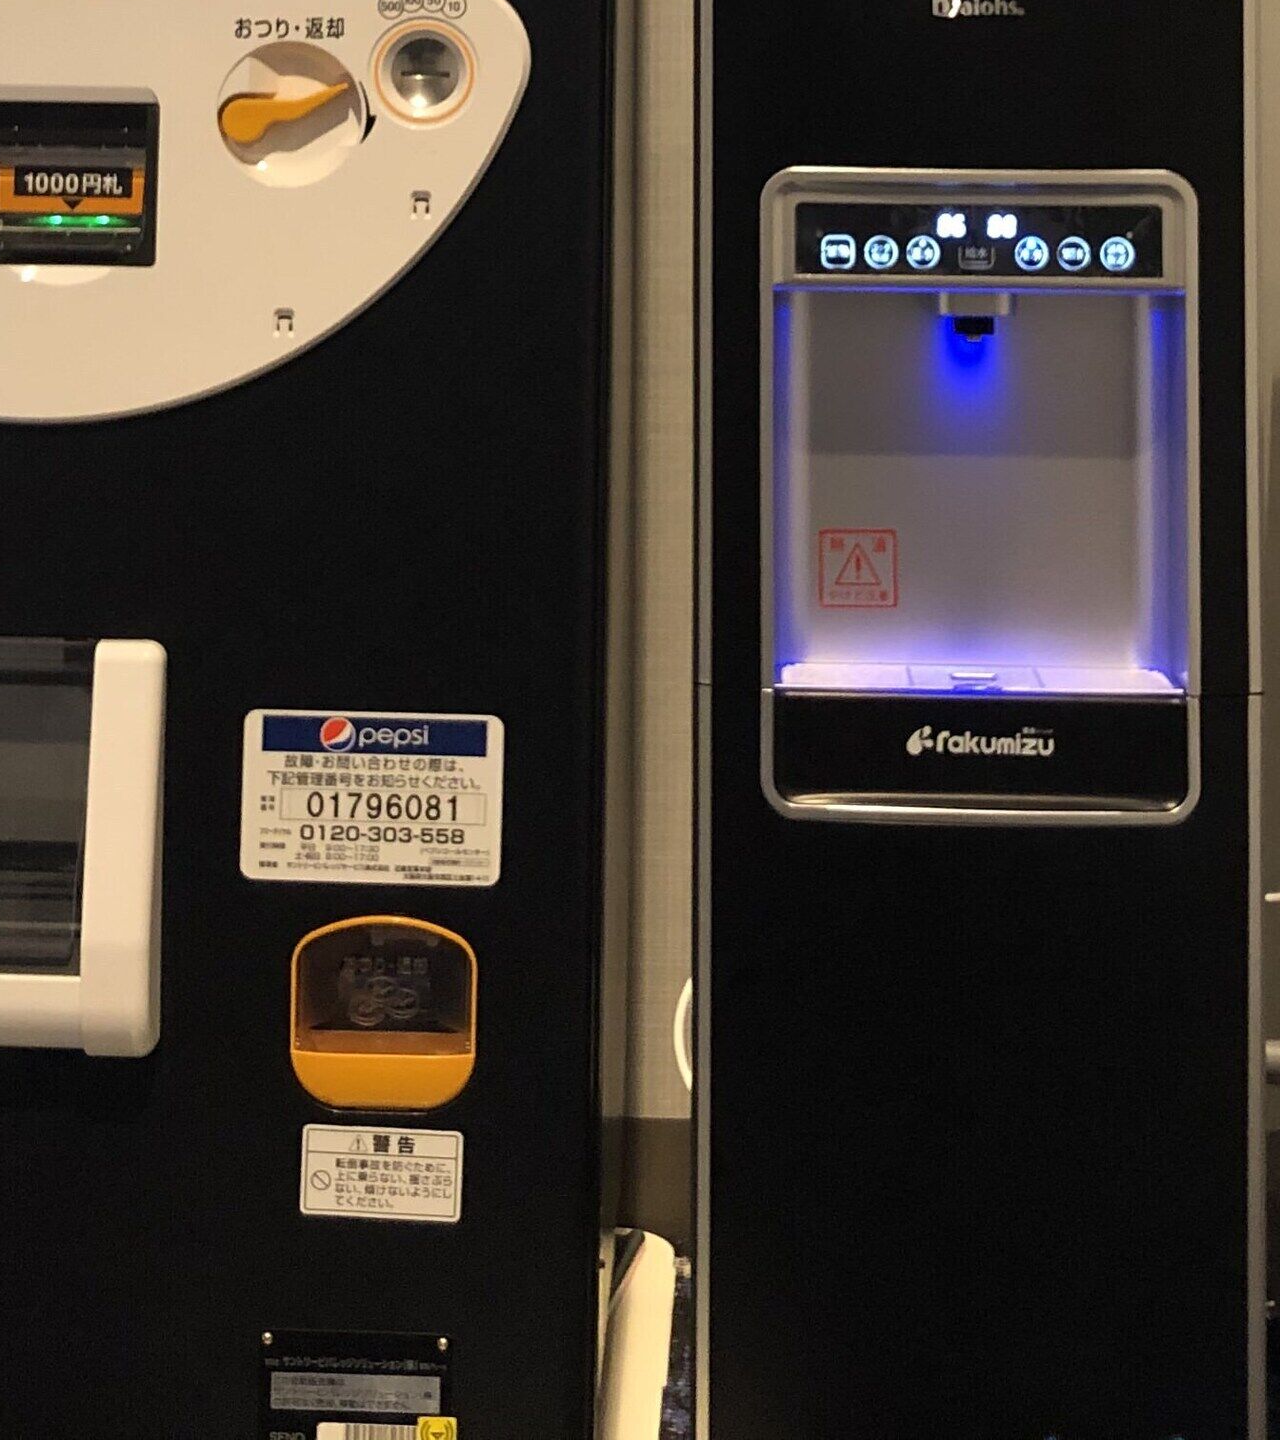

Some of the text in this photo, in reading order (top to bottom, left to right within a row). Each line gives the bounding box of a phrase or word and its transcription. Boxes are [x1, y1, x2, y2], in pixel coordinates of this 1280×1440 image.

[380, 0, 401, 13] 500
[447, 1, 461, 12] 10
[234, 17, 345, 40] おつり・返却
[24, 171, 123, 197] 1000円札
[358, 725, 429, 749] pepsi
[936, 729, 1055, 757] rakumizu
[269, 771, 481, 790] 下記管理番号をお知らせください。
[306, 791, 458, 822] 01796081
[300, 824, 465, 844] 0120-303-558
[373, 1134, 416, 1154] 警告
